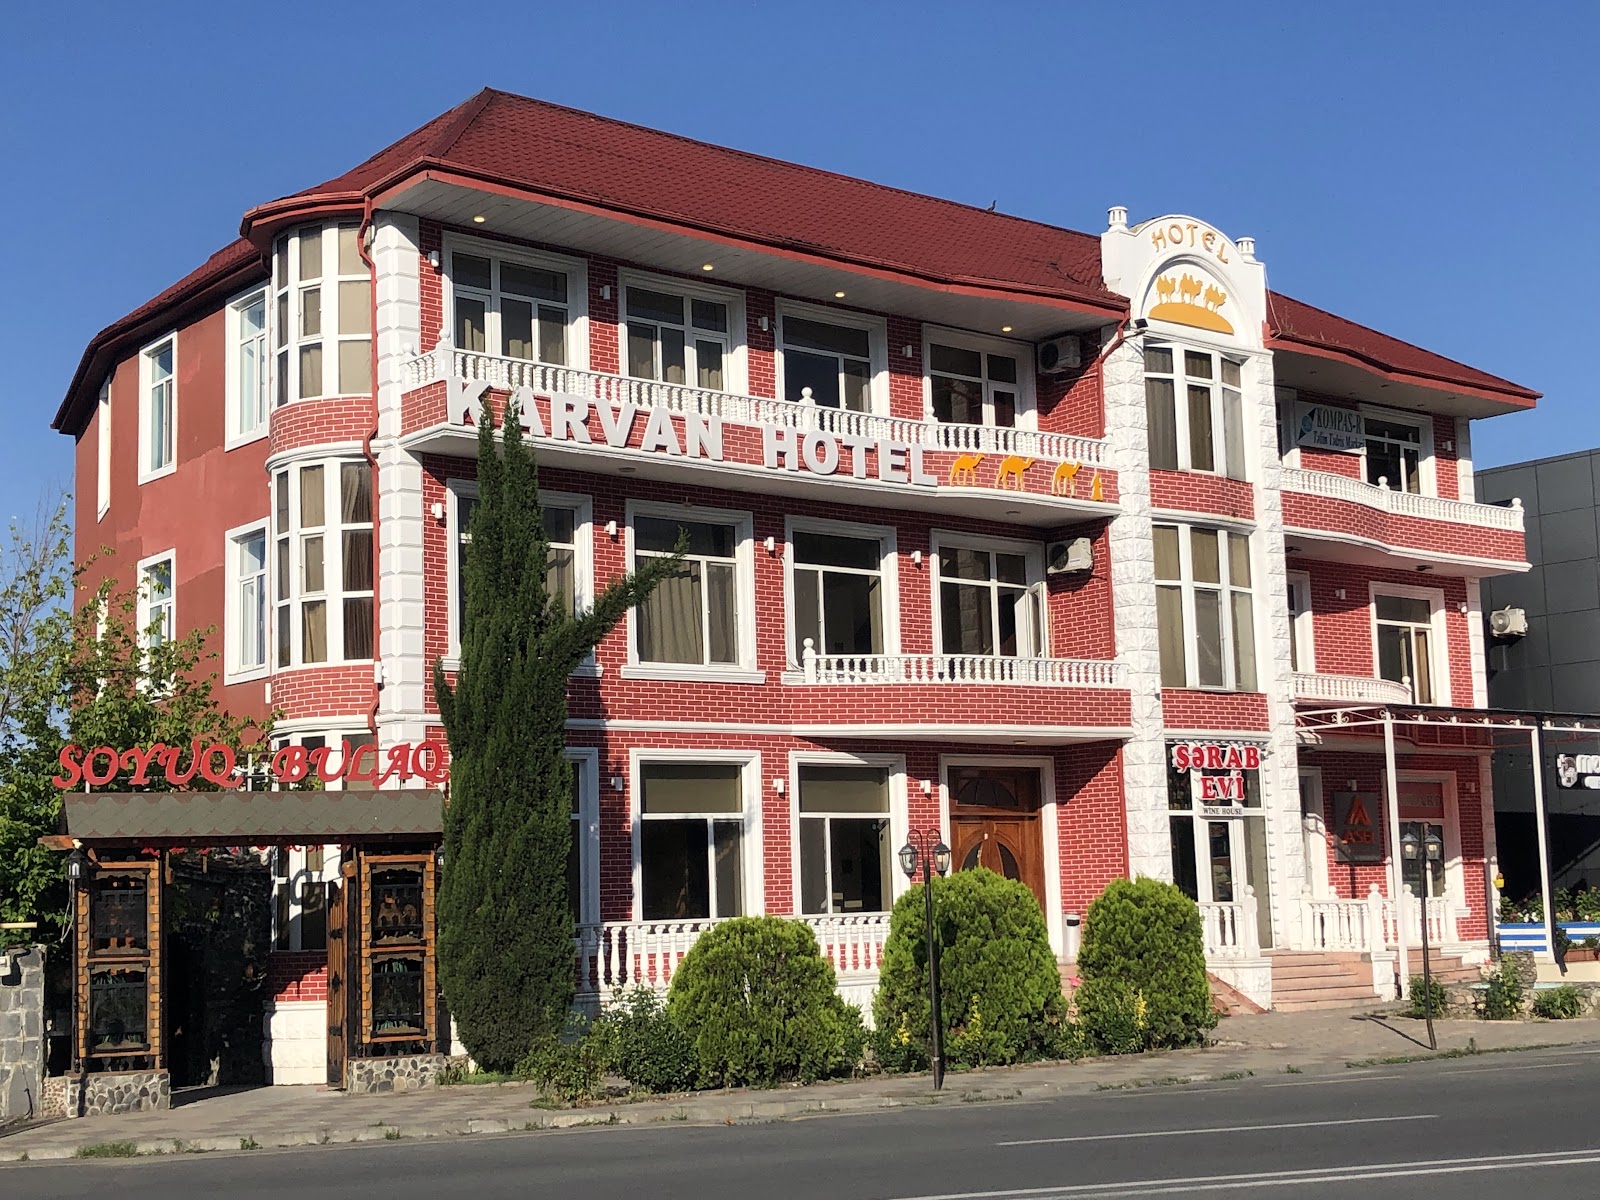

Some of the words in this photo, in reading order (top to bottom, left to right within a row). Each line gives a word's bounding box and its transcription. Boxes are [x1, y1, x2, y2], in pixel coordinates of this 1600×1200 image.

[1151, 223, 1229, 264] HOTEL
[446, 376, 723, 461] KARVAN
[762, 423, 938, 487] HOTEL
[52, 739, 243, 789] SOYUQ
[271, 739, 450, 786] BULAQ
[1200, 771, 1245, 800] EVİ
